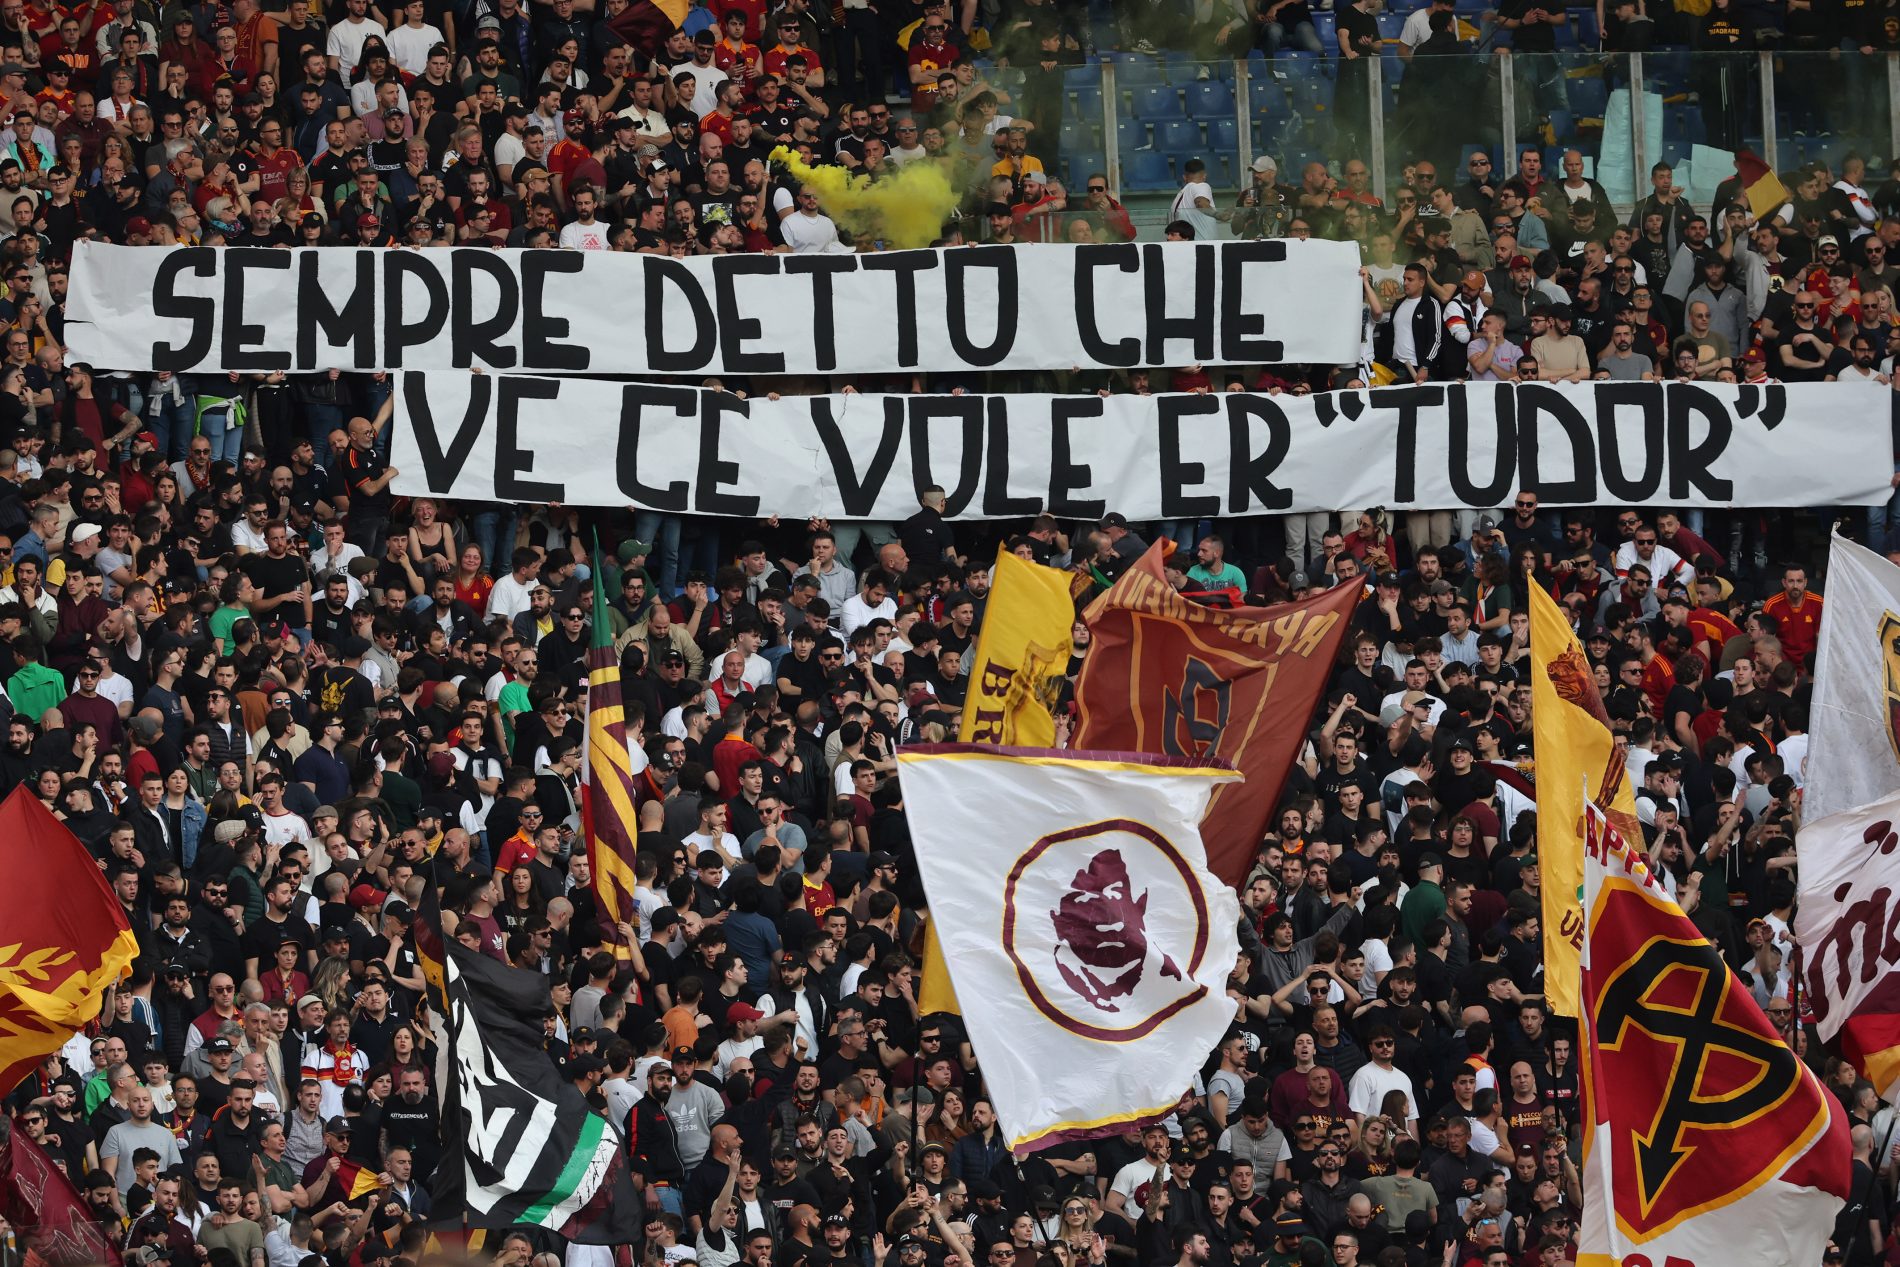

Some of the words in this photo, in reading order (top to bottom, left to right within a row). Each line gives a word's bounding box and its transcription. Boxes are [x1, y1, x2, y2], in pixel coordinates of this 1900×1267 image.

[152, 247, 590, 372] SEMPRE
[643, 242, 1018, 373] DETTO
[1074, 241, 1286, 367] CHE
[403, 370, 565, 503] VE
[616, 384, 760, 516] CE
[810, 395, 1105, 518] VOLE
[1157, 393, 1293, 517] ER
[1313, 383, 1787, 507] "TUDOR"
